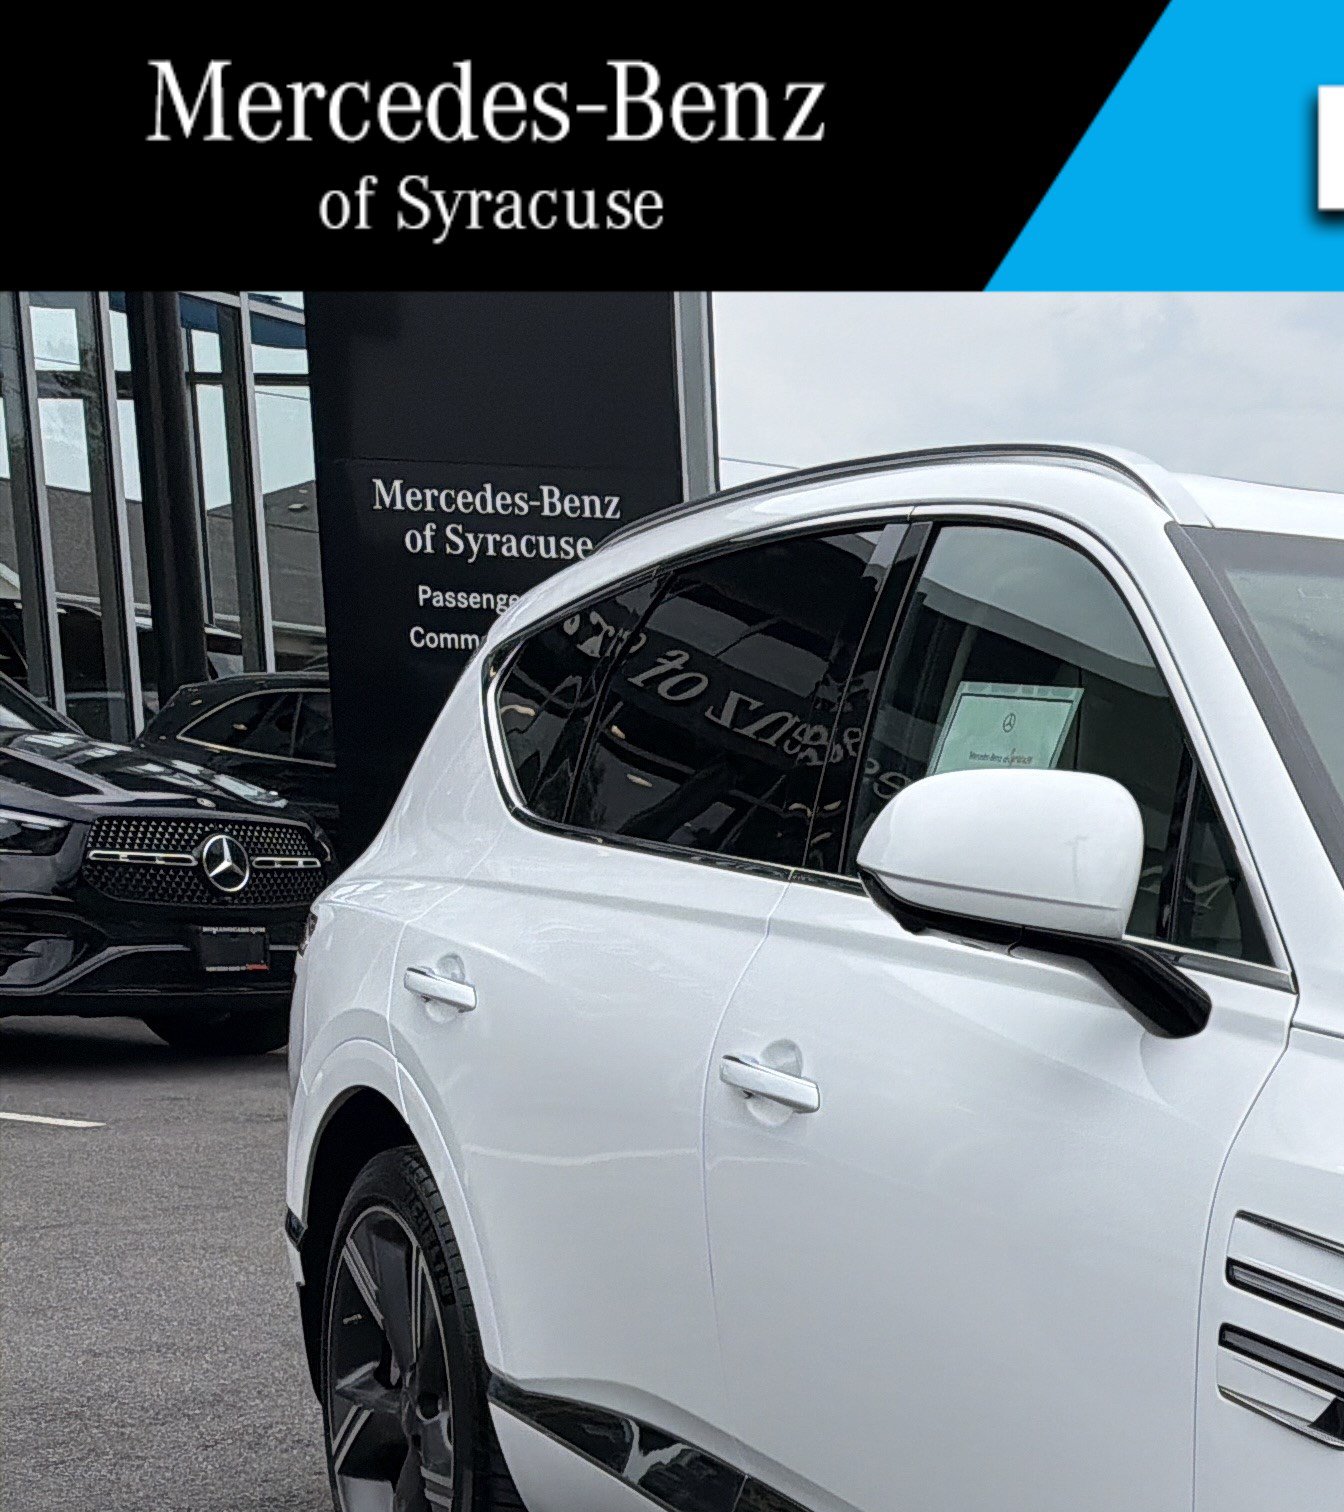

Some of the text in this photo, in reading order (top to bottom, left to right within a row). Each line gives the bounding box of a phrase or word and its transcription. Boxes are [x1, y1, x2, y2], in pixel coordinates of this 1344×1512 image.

[372, 478, 621, 520] Mercedes-Benz
[404, 522, 594, 564] of Syracuse
[409, 625, 486, 650] Comm
